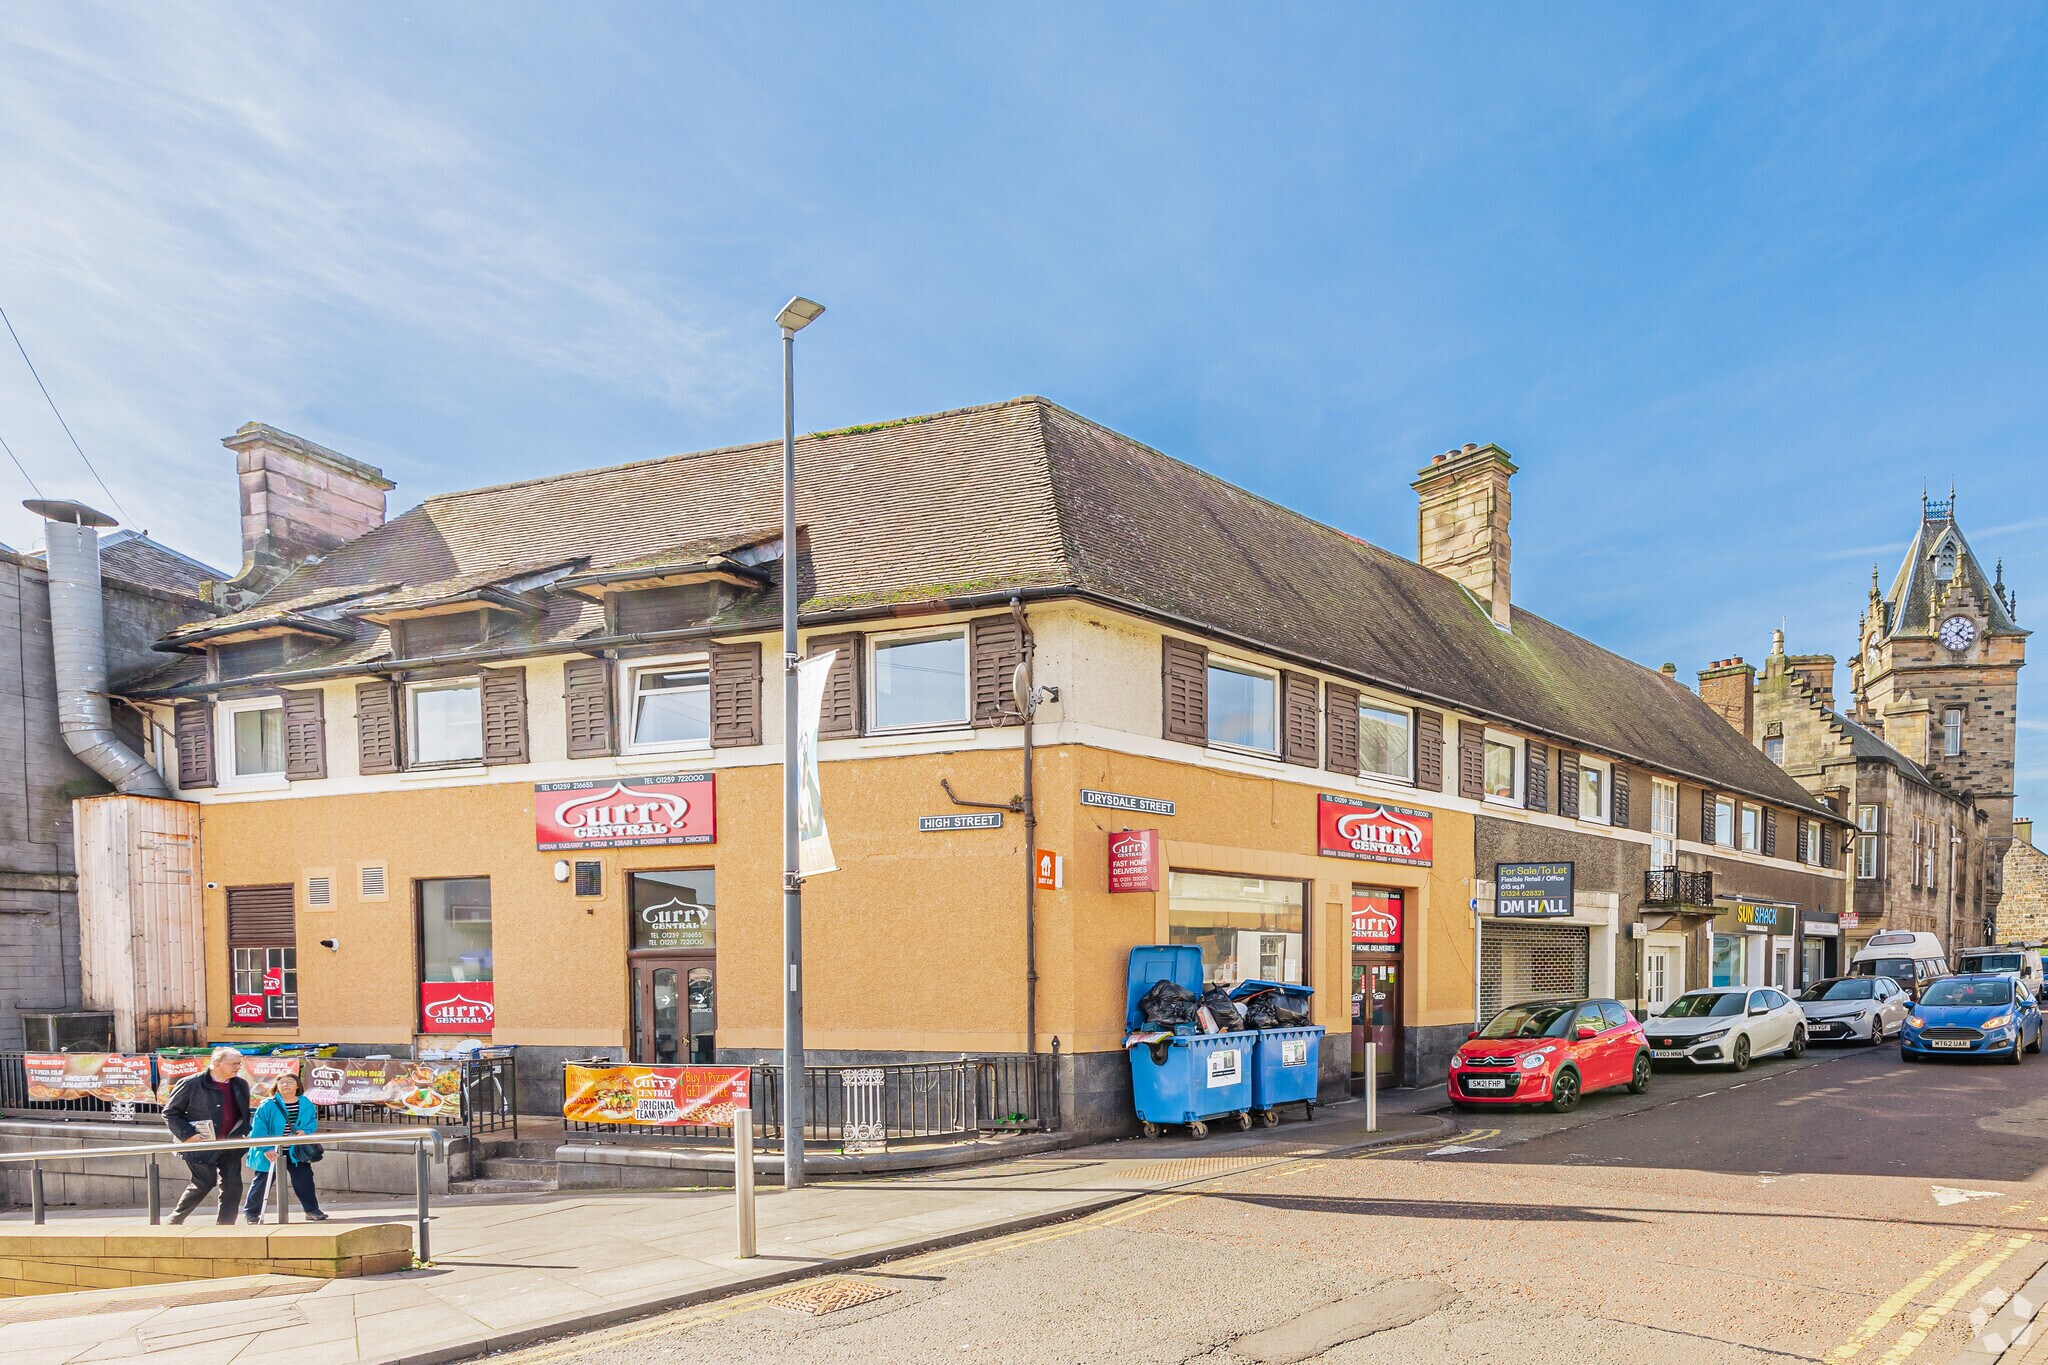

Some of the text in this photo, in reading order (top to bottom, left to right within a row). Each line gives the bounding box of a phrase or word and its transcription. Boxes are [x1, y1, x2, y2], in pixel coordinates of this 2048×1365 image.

[656, 776, 675, 784] 01259
[678, 774, 704, 782] 722000
[554, 780, 688, 829] Curry
[1087, 793, 1171, 812] DRYSDALE STREET
[925, 816, 994, 828] HIGH STREET
[1338, 805, 1423, 853] Curry
[573, 823, 669, 839] CENTRAL
[1112, 836, 1147, 854] Curry
[1351, 839, 1411, 856] CENTRAL
[1113, 858, 1147, 868] FAST HOME
[1113, 866, 1147, 875] DELIVERIES
[1501, 866, 1567, 875] For Sale/To Let
[642, 896, 709, 926] Curry
[1500, 900, 1568, 914] DM HALL
[1738, 905, 1777, 924] SUN SHACK
[234, 1001, 262, 1016] Curry
[425, 993, 494, 1020] Curry
[311, 1065, 344, 1080] Curry
[685, 1072, 700, 1084] Buy
[314, 1079, 340, 1087] CENTRAL
[634, 1073, 677, 1089] Curry
[637, 1089, 673, 1098] CENTRAL
[685, 1085, 702, 1097] GET
[710, 1086, 729, 1097] FREE
[639, 1100, 675, 1110] ORIGINAL
[636, 1109, 656, 1119] TEAM
